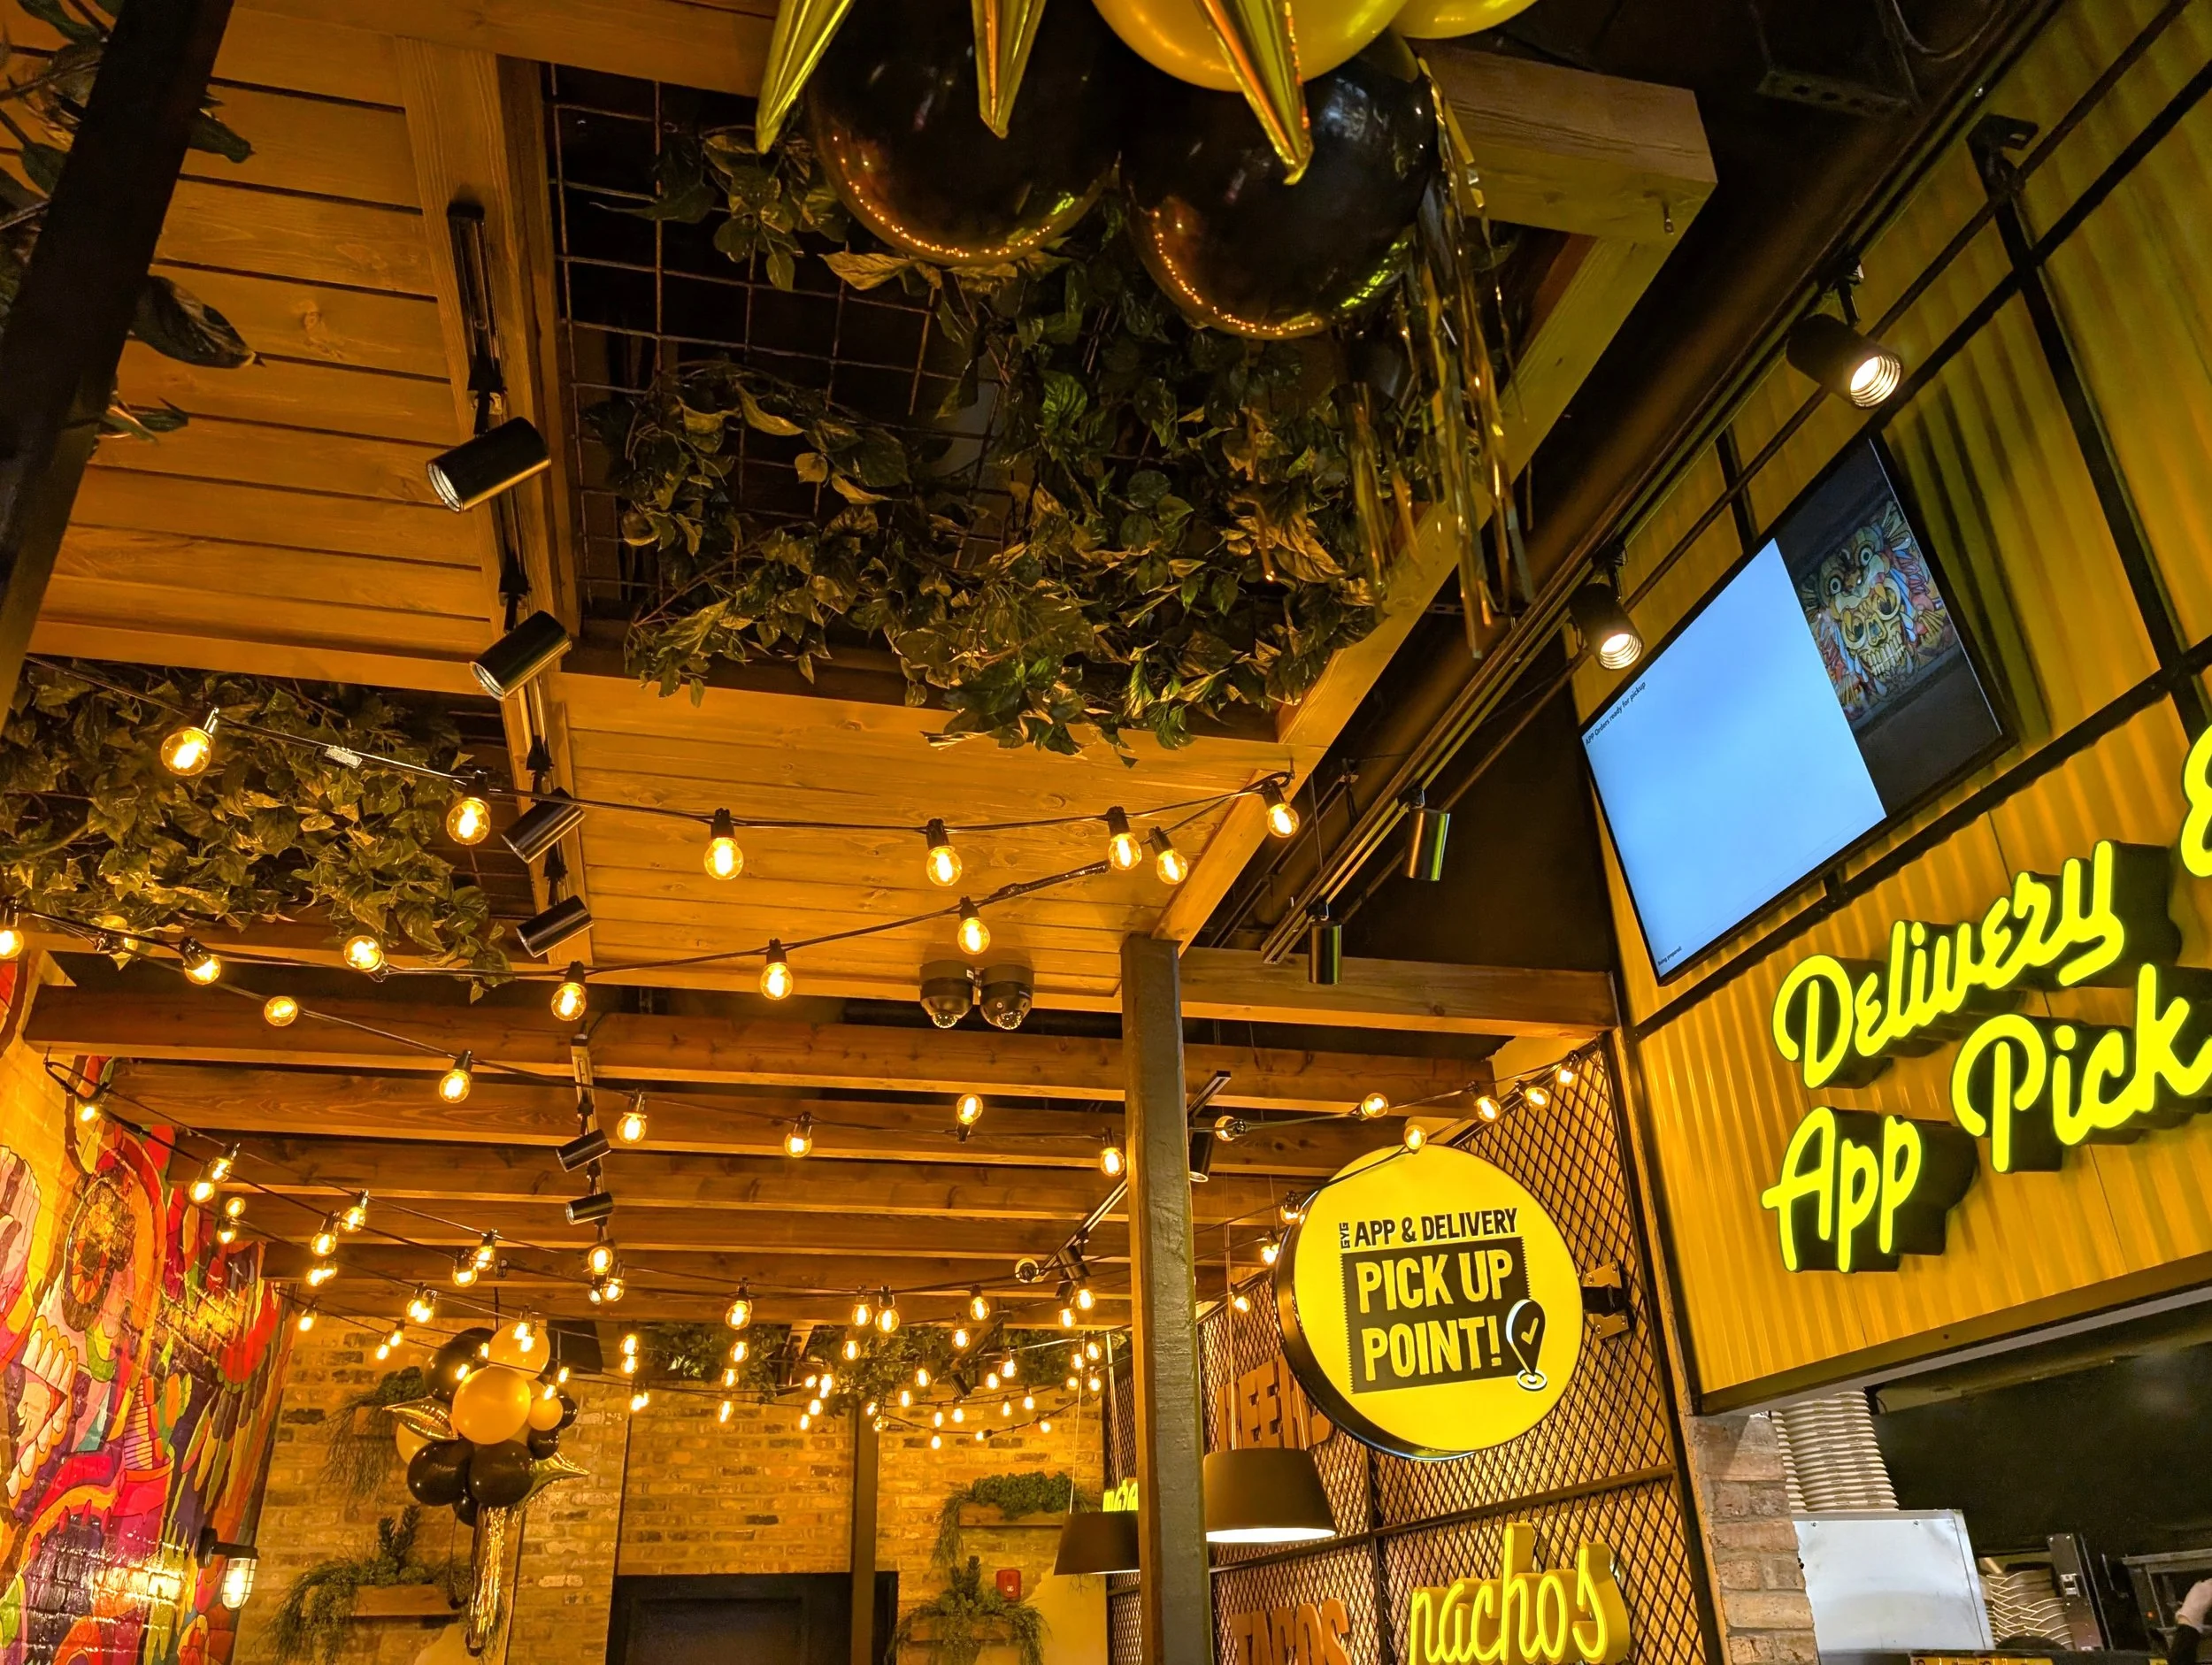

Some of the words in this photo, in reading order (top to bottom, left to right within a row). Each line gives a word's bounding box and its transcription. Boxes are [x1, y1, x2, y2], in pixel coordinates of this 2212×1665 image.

[1594, 718, 1609, 736] Orders
[1609, 705, 1623, 721] ready
[1630, 682, 1646, 702] pickup
[1772, 840, 2124, 1088] Delivery
[1761, 1106, 1923, 1273] App
[1339, 1222, 1351, 1249] GYG
[1354, 1219, 1396, 1247] APP
[1402, 1216, 1417, 1243] &
[1421, 1208, 1517, 1241] DELIVERY
[1356, 1254, 1454, 1314] PICK
[1458, 1249, 1513, 1302] UP
[1361, 1316, 1502, 1382] POINT!
[1409, 1523, 1608, 1665] nachos
